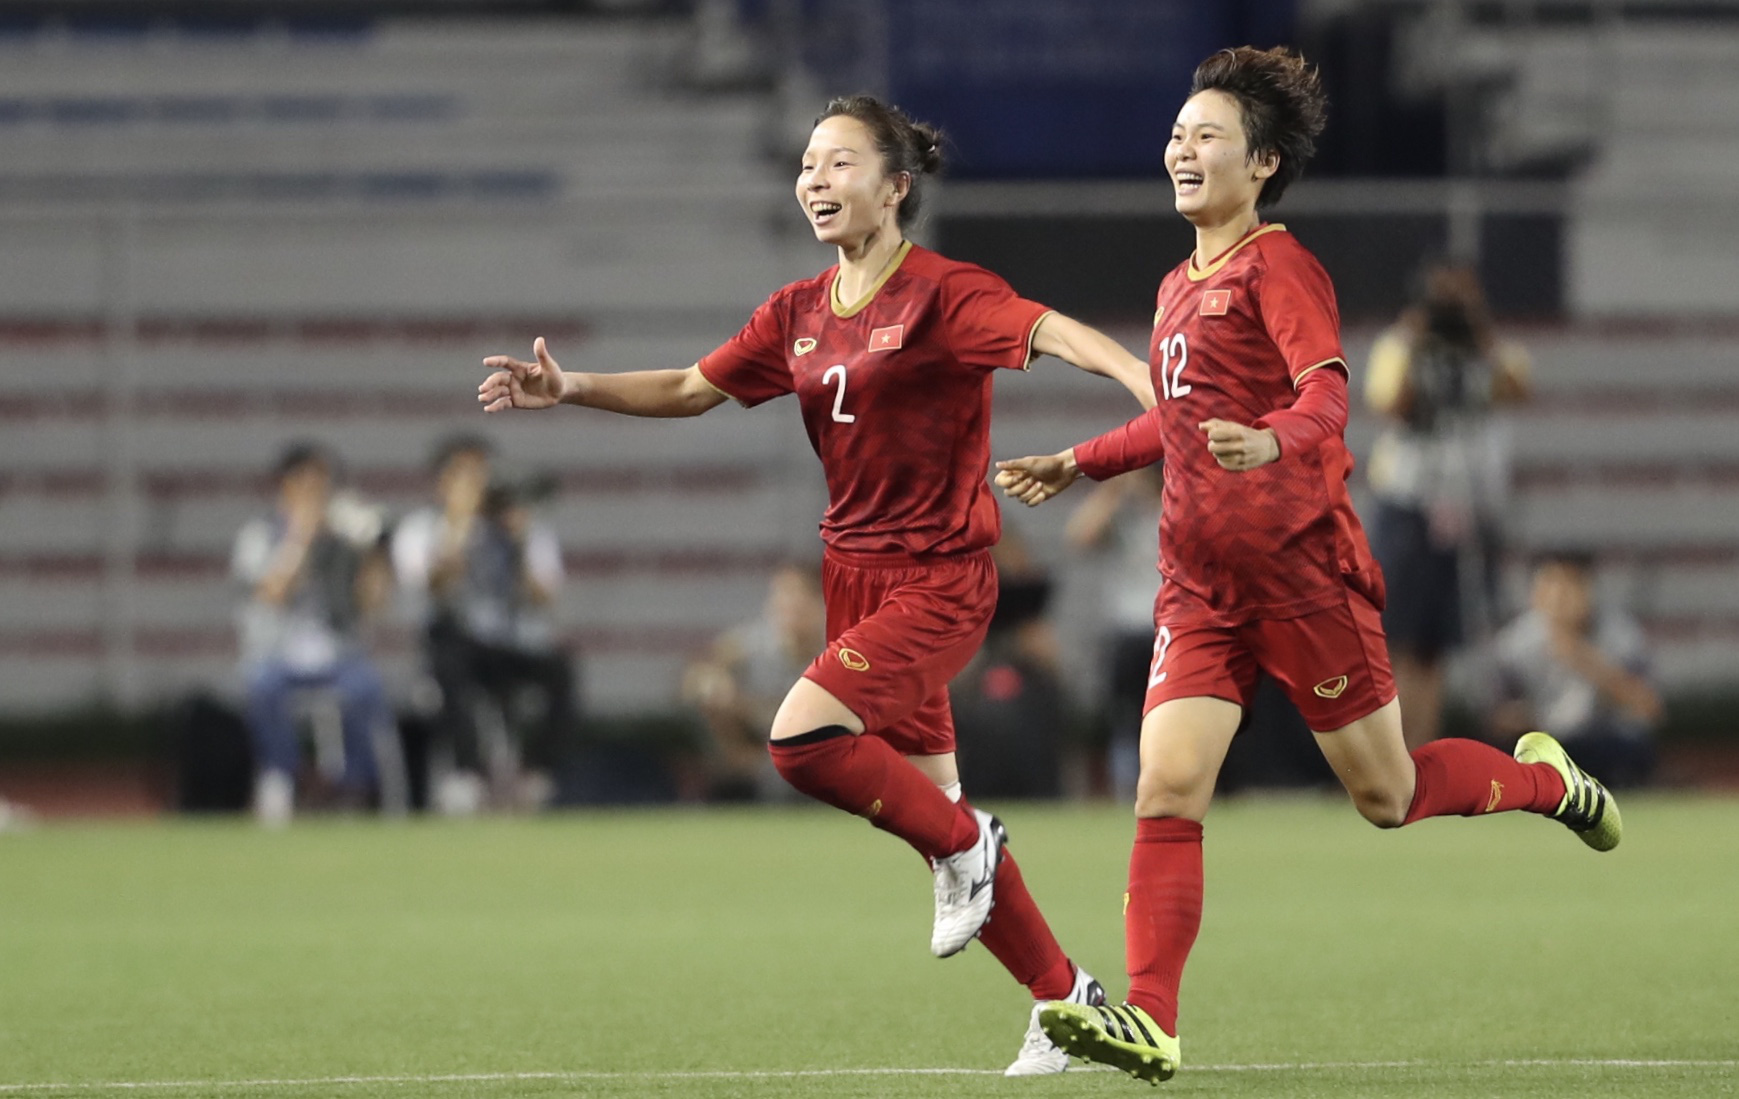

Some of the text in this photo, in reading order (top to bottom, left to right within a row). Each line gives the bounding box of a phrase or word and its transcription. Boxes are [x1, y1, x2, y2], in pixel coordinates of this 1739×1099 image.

[822, 364, 856, 423] 2
[1158, 332, 1192, 401] 12
[1148, 625, 1171, 689] 2
